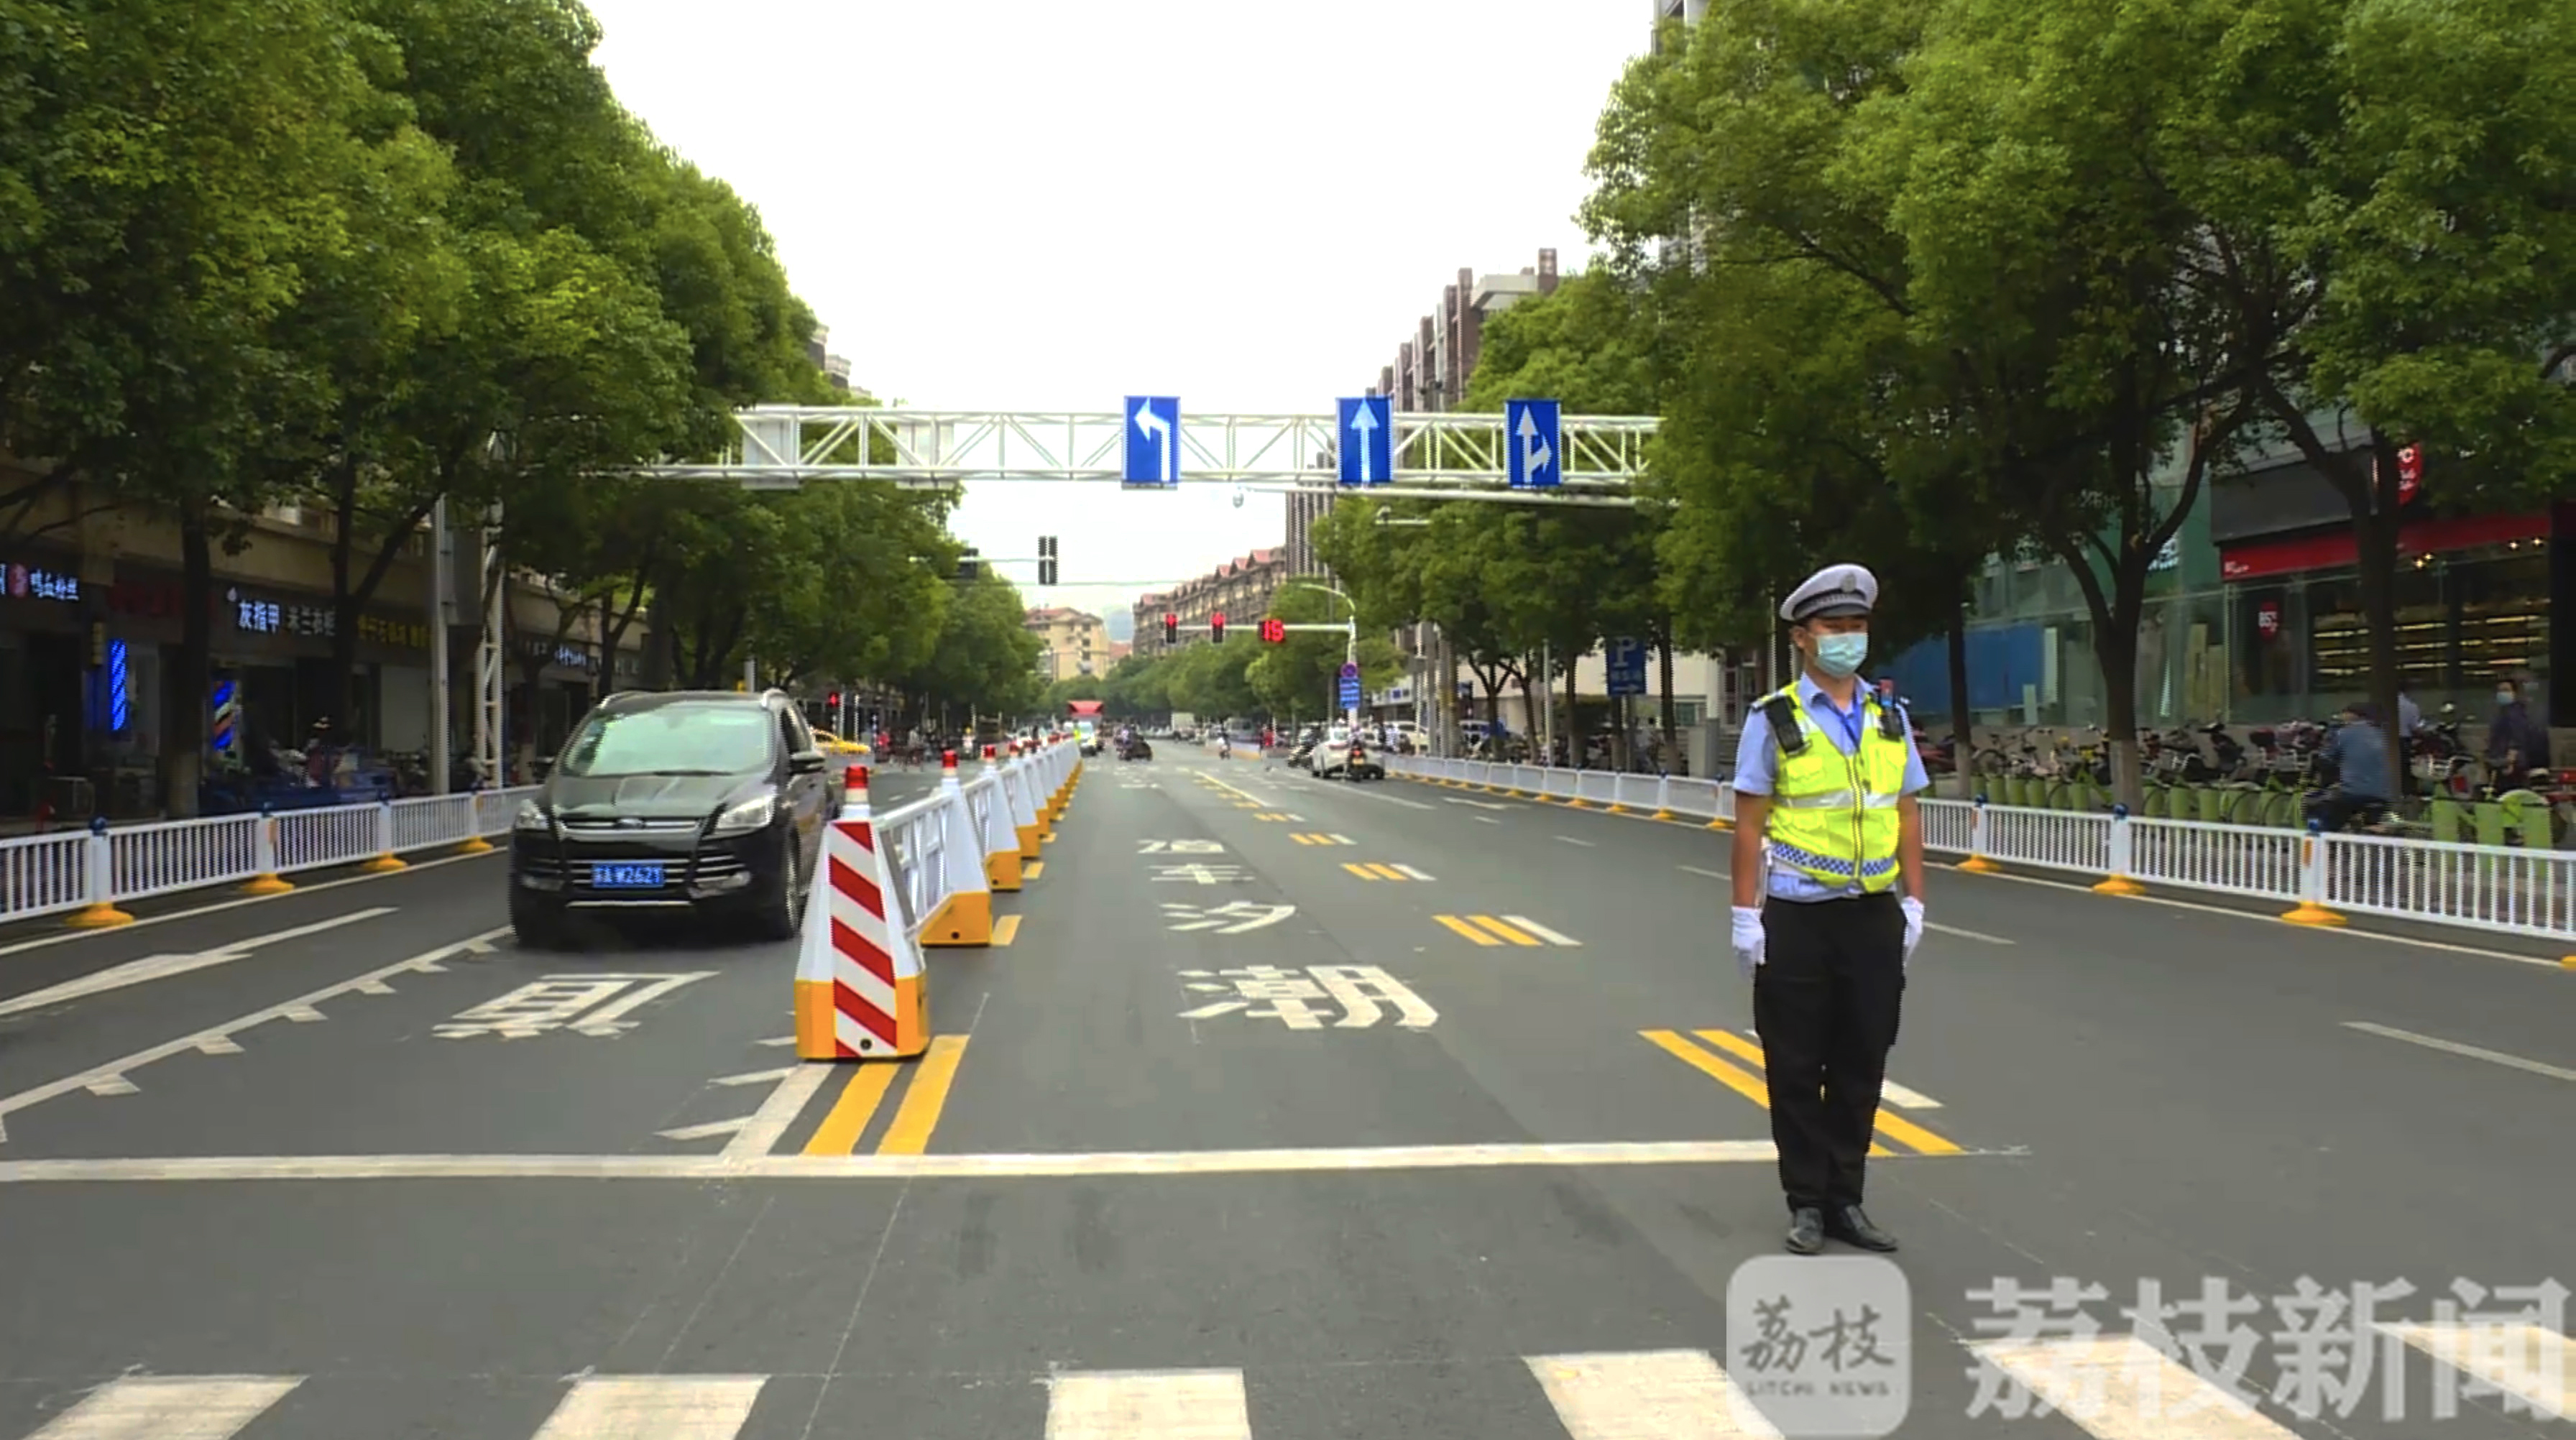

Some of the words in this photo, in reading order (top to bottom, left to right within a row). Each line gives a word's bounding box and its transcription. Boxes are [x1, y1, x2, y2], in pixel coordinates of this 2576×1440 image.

[239, 598, 280, 634] 灰指甲
[1264, 619, 1284, 641] 15
